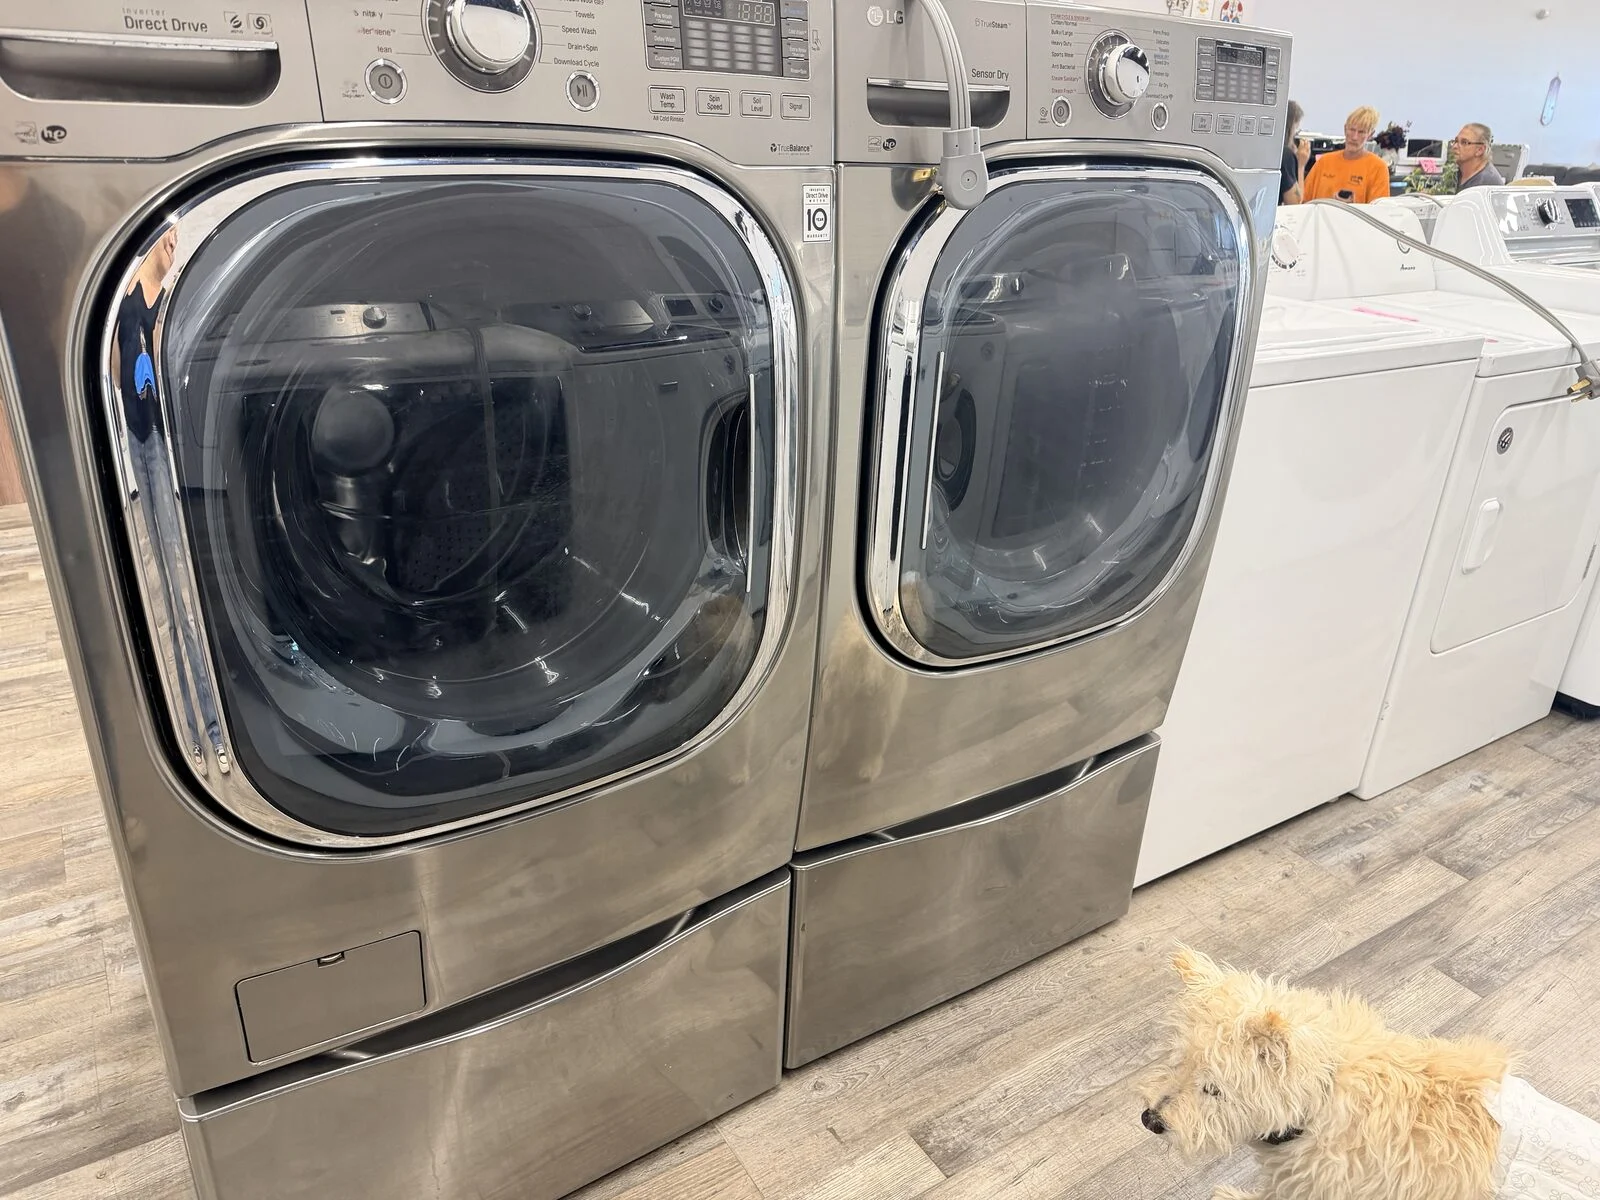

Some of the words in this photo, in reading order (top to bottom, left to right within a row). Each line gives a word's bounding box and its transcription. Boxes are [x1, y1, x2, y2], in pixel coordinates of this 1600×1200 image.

[122, 7, 166, 16] Inverter
[574, 10, 596, 19] Towels
[885, 9, 904, 25] LG
[123, 15, 169, 31] Direct
[171, 18, 208, 33] Drive
[561, 25, 580, 34] Speed
[580, 27, 597, 35] Wash
[567, 42, 599, 52] Drain+Spin
[553, 57, 583, 66] Download
[583, 59, 600, 68] Cycle
[971, 68, 996, 79] Sensor
[997, 69, 1010, 82] Dry
[659, 92, 676, 100] Wash
[708, 94, 721, 103] Spin
[659, 100, 676, 109] Temp
[706, 102, 723, 112] Speed
[750, 104, 764, 112] Level
[788, 102, 803, 111] Signal
[777, 143, 811, 152] TrueBalance
[806, 207, 828, 232] 10
